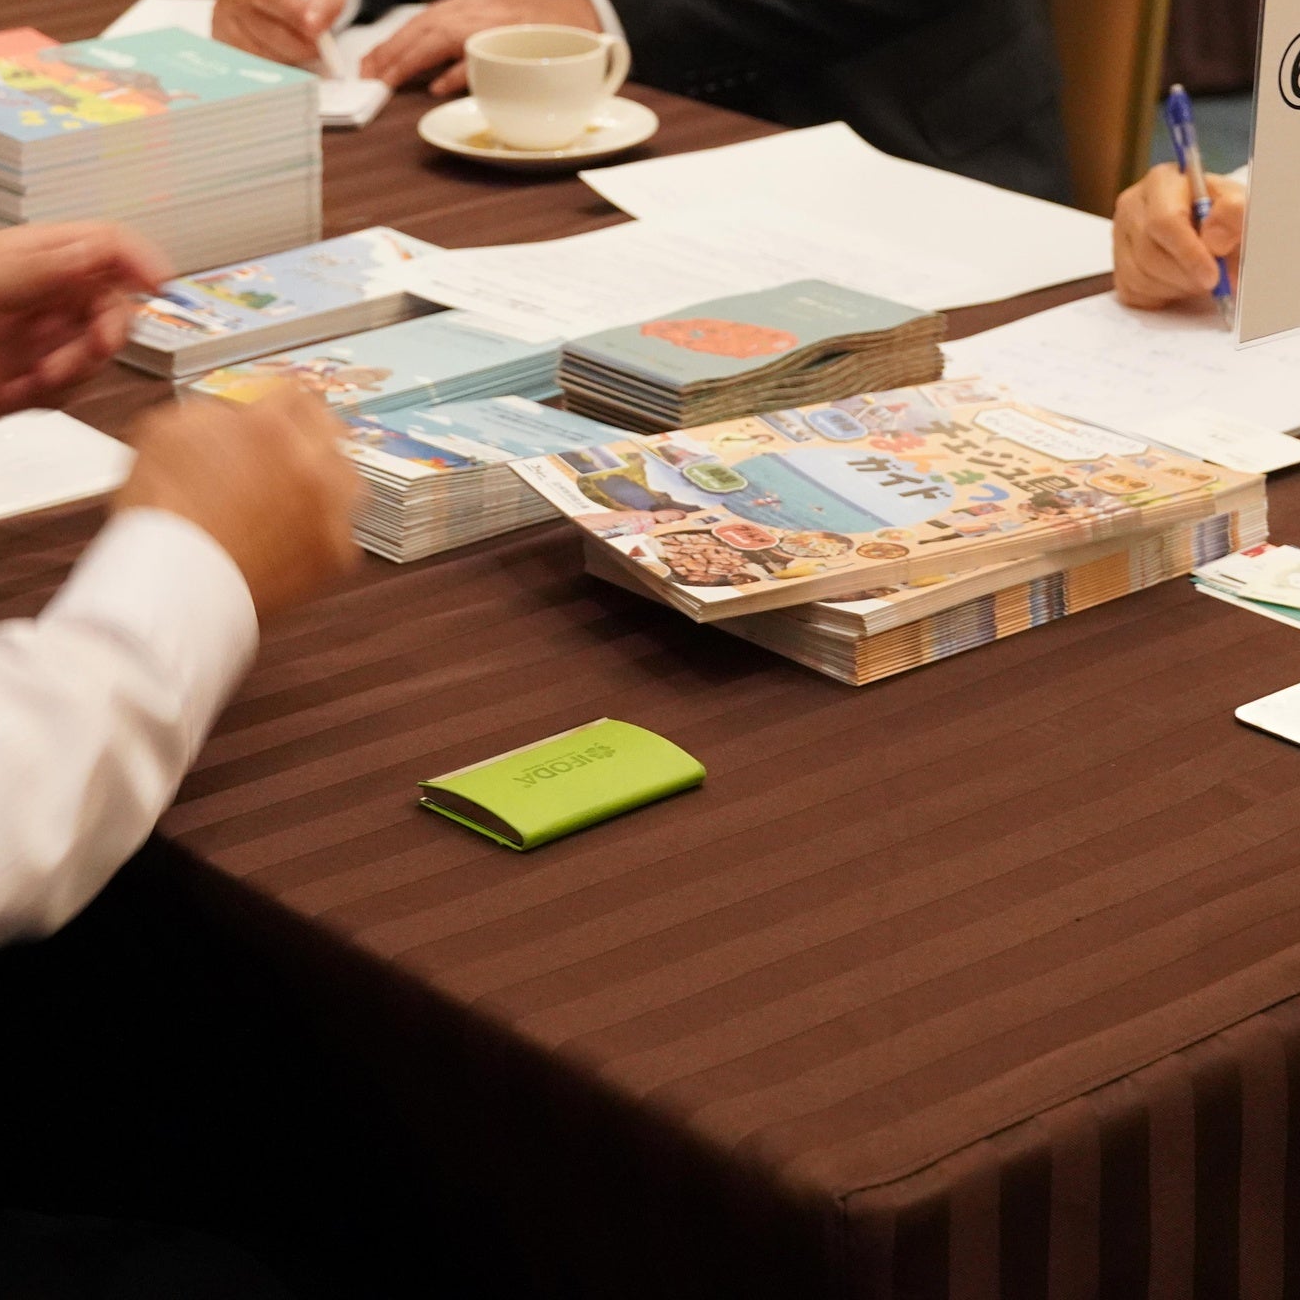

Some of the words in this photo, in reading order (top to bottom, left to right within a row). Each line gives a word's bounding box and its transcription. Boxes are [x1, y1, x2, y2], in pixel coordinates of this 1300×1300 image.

[847, 456, 951, 500] ガイド
[512, 755, 594, 786] IFODA
